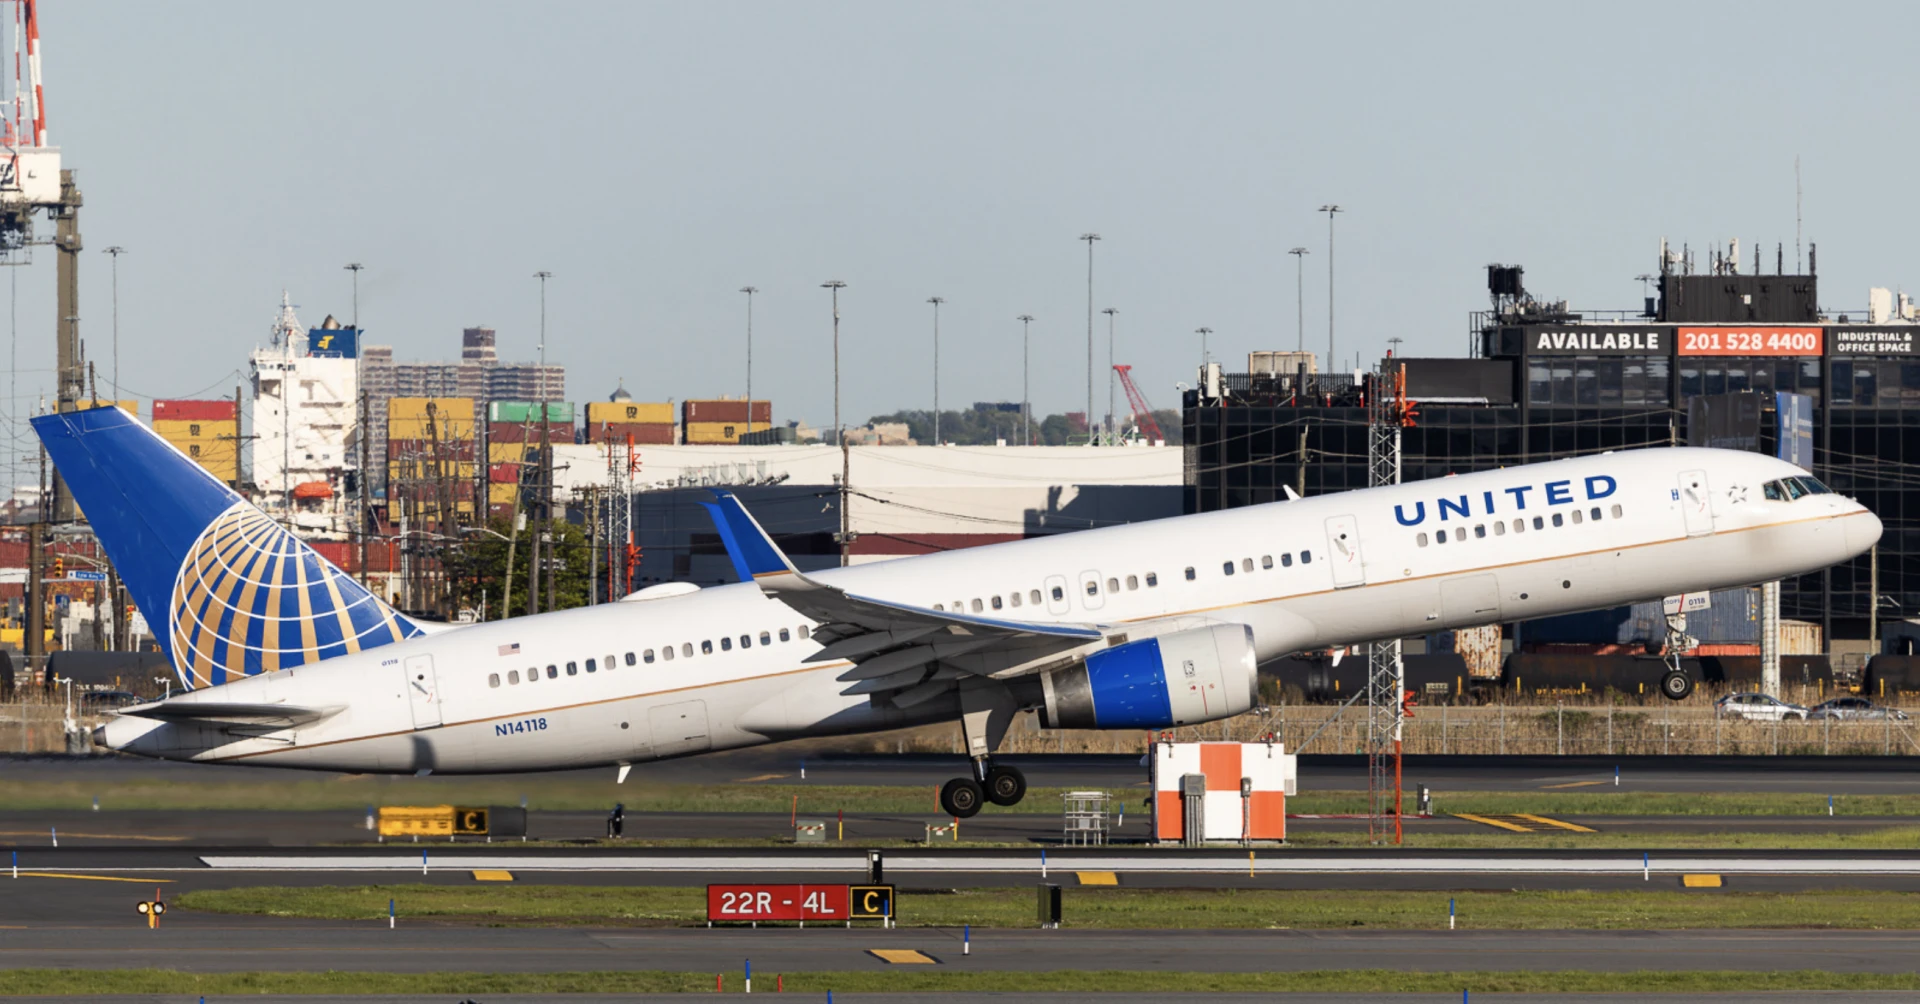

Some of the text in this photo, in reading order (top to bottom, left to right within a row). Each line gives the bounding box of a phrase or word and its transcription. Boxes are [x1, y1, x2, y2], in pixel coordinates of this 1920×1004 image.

[1537, 332, 1659, 349] AVAILABLE
[1684, 333, 1816, 350] 201 528 4400
[1837, 332, 1912, 341] INDUSTRIAL &
[1837, 343, 1911, 352] OFFICE SPACE
[1394, 475, 1617, 527] UNITED
[1688, 597, 1706, 606] 0118
[495, 717, 547, 736] N14118
[464, 812, 477, 830] C
[721, 891, 772, 914] 22R
[803, 891, 835, 914] 4L
[863, 891, 879, 913] C
